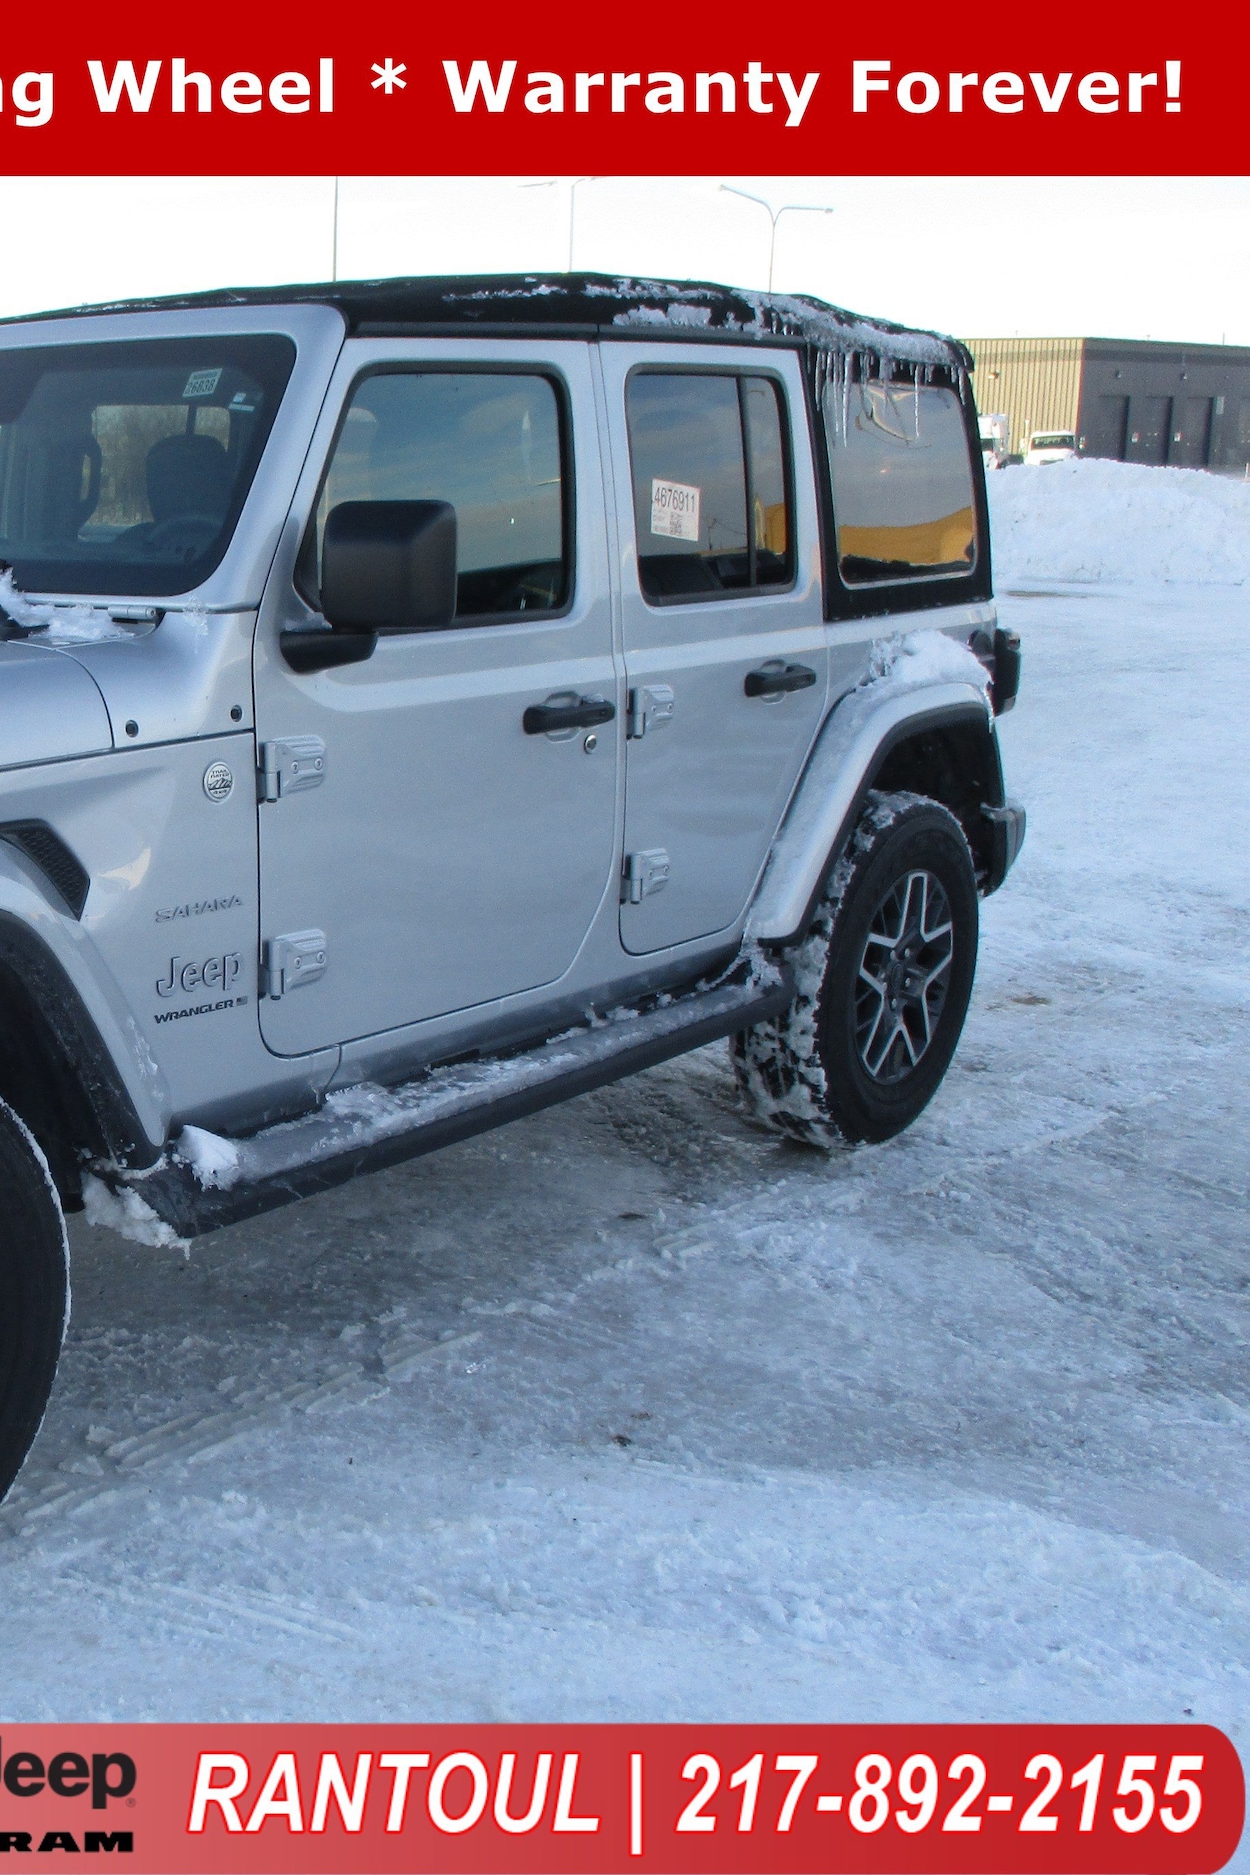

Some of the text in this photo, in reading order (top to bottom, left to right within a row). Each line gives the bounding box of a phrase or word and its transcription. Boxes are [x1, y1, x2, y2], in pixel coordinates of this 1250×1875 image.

[655, 487, 695, 512] 4676911
[155, 895, 244, 923] SAHARA
[156, 952, 244, 998] Jeep
[154, 999, 234, 1024] WRANGLER
